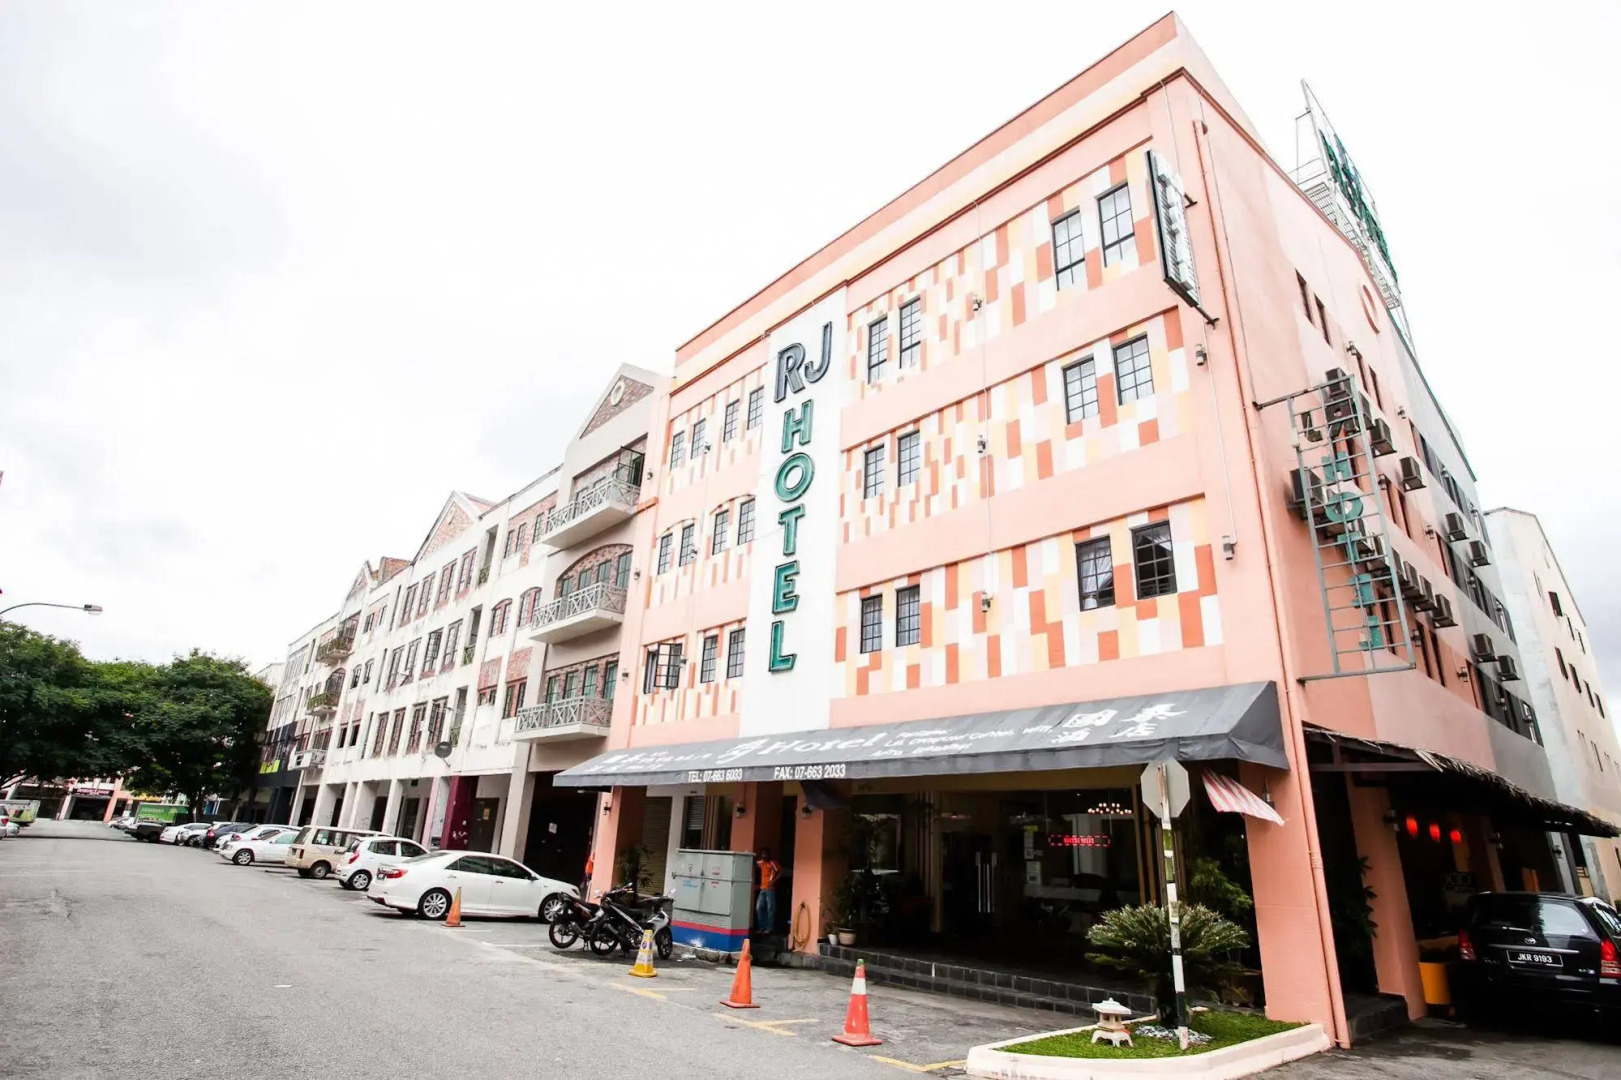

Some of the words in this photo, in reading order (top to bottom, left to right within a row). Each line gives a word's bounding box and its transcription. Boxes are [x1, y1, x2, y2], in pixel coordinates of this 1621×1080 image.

[774, 321, 832, 402] RJ
[768, 398, 815, 674] HOTEL
[758, 732, 888, 755] Hotel
[774, 767, 793, 779] FAX:
[795, 766, 823, 779] 07-663
[824, 764, 846, 778] 2033
[1518, 953, 1532, 962] JKR
[1534, 954, 1553, 963] 9193
